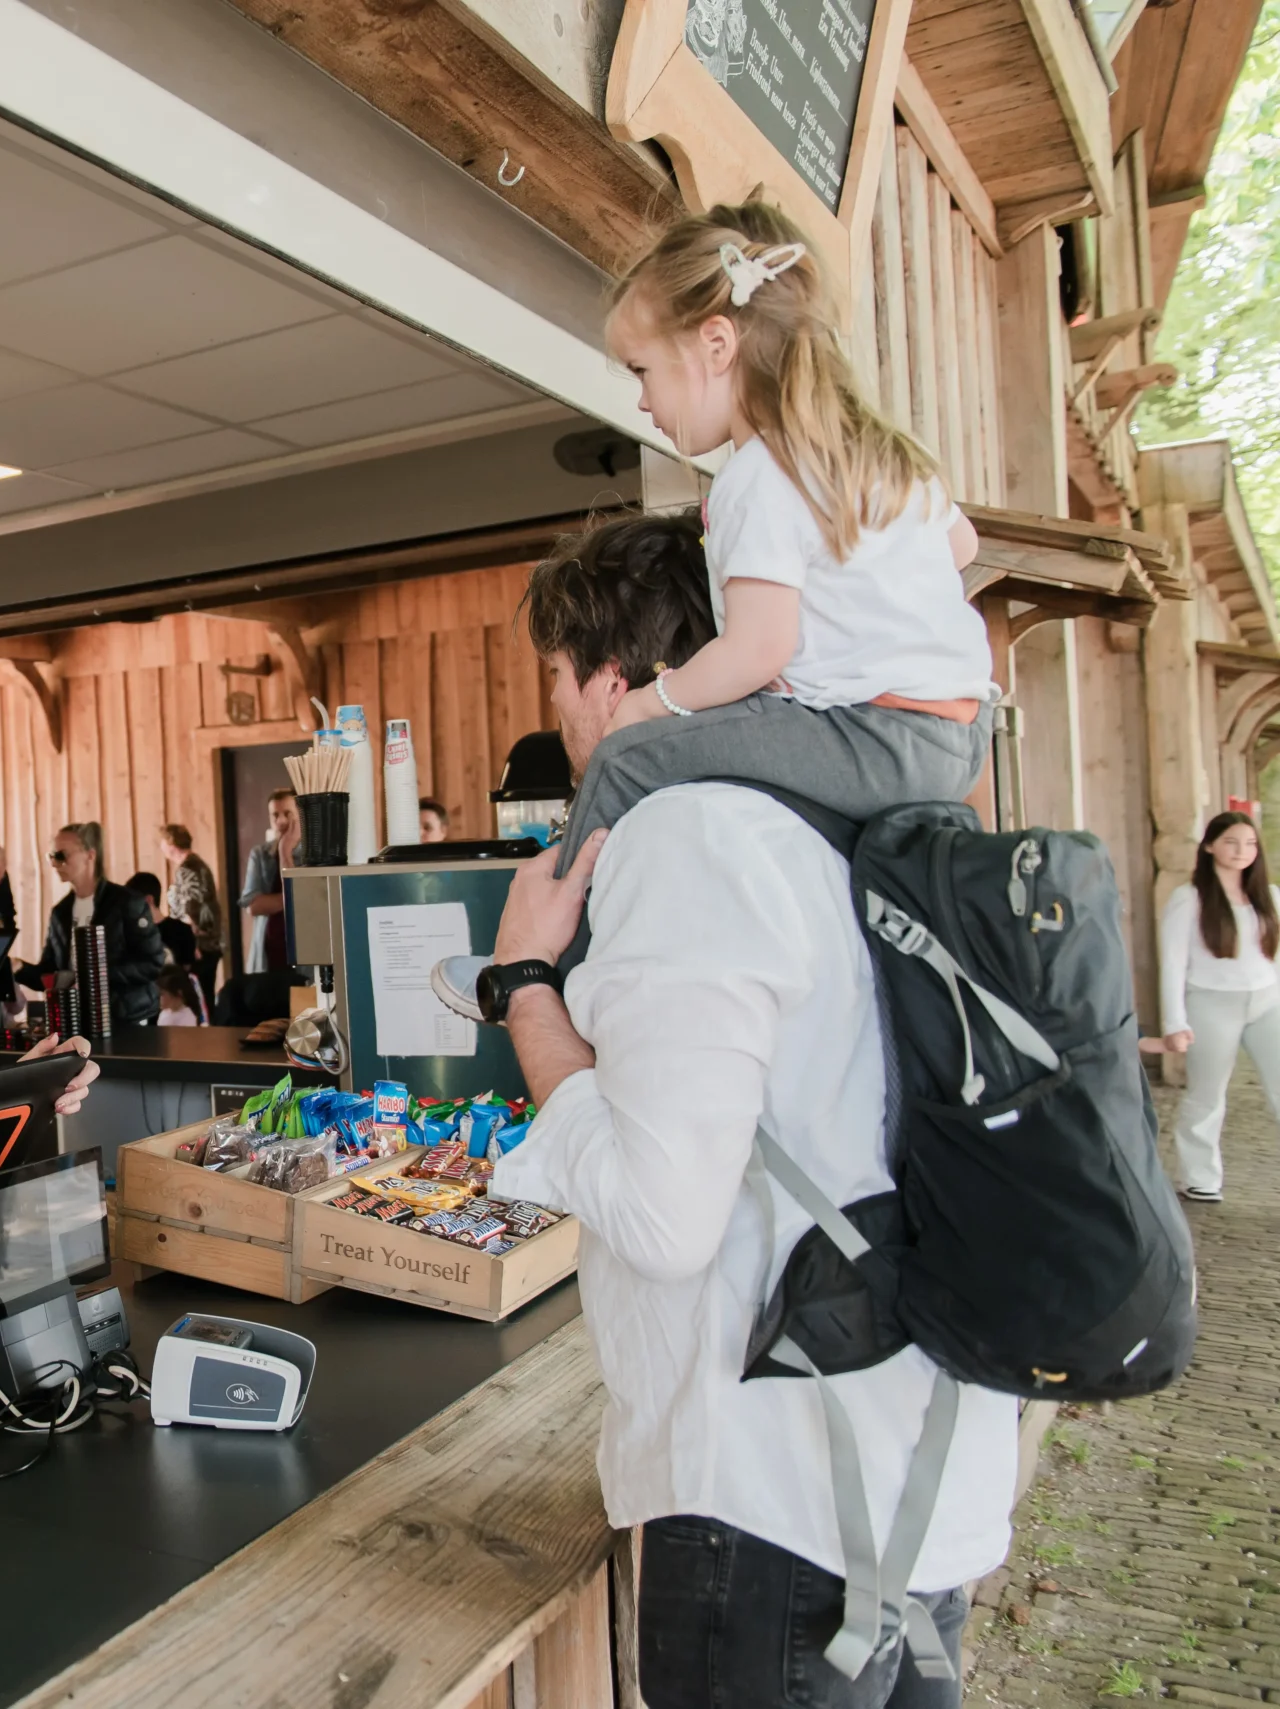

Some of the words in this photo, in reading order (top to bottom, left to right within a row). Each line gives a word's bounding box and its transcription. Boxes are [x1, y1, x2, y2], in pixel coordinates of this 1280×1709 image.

[749, 28, 769, 66] Broodje
[770, 55, 784, 85] Unox
[745, 52, 772, 98] Frisdrank
[771, 90, 784, 112] naar
[378, 1095, 405, 1114] HARIBO
[332, 1191, 363, 1209] Mars
[375, 1200, 407, 1222] Mars
[320, 1233, 374, 1263] Treat
[380, 1246, 471, 1284] Yourself
